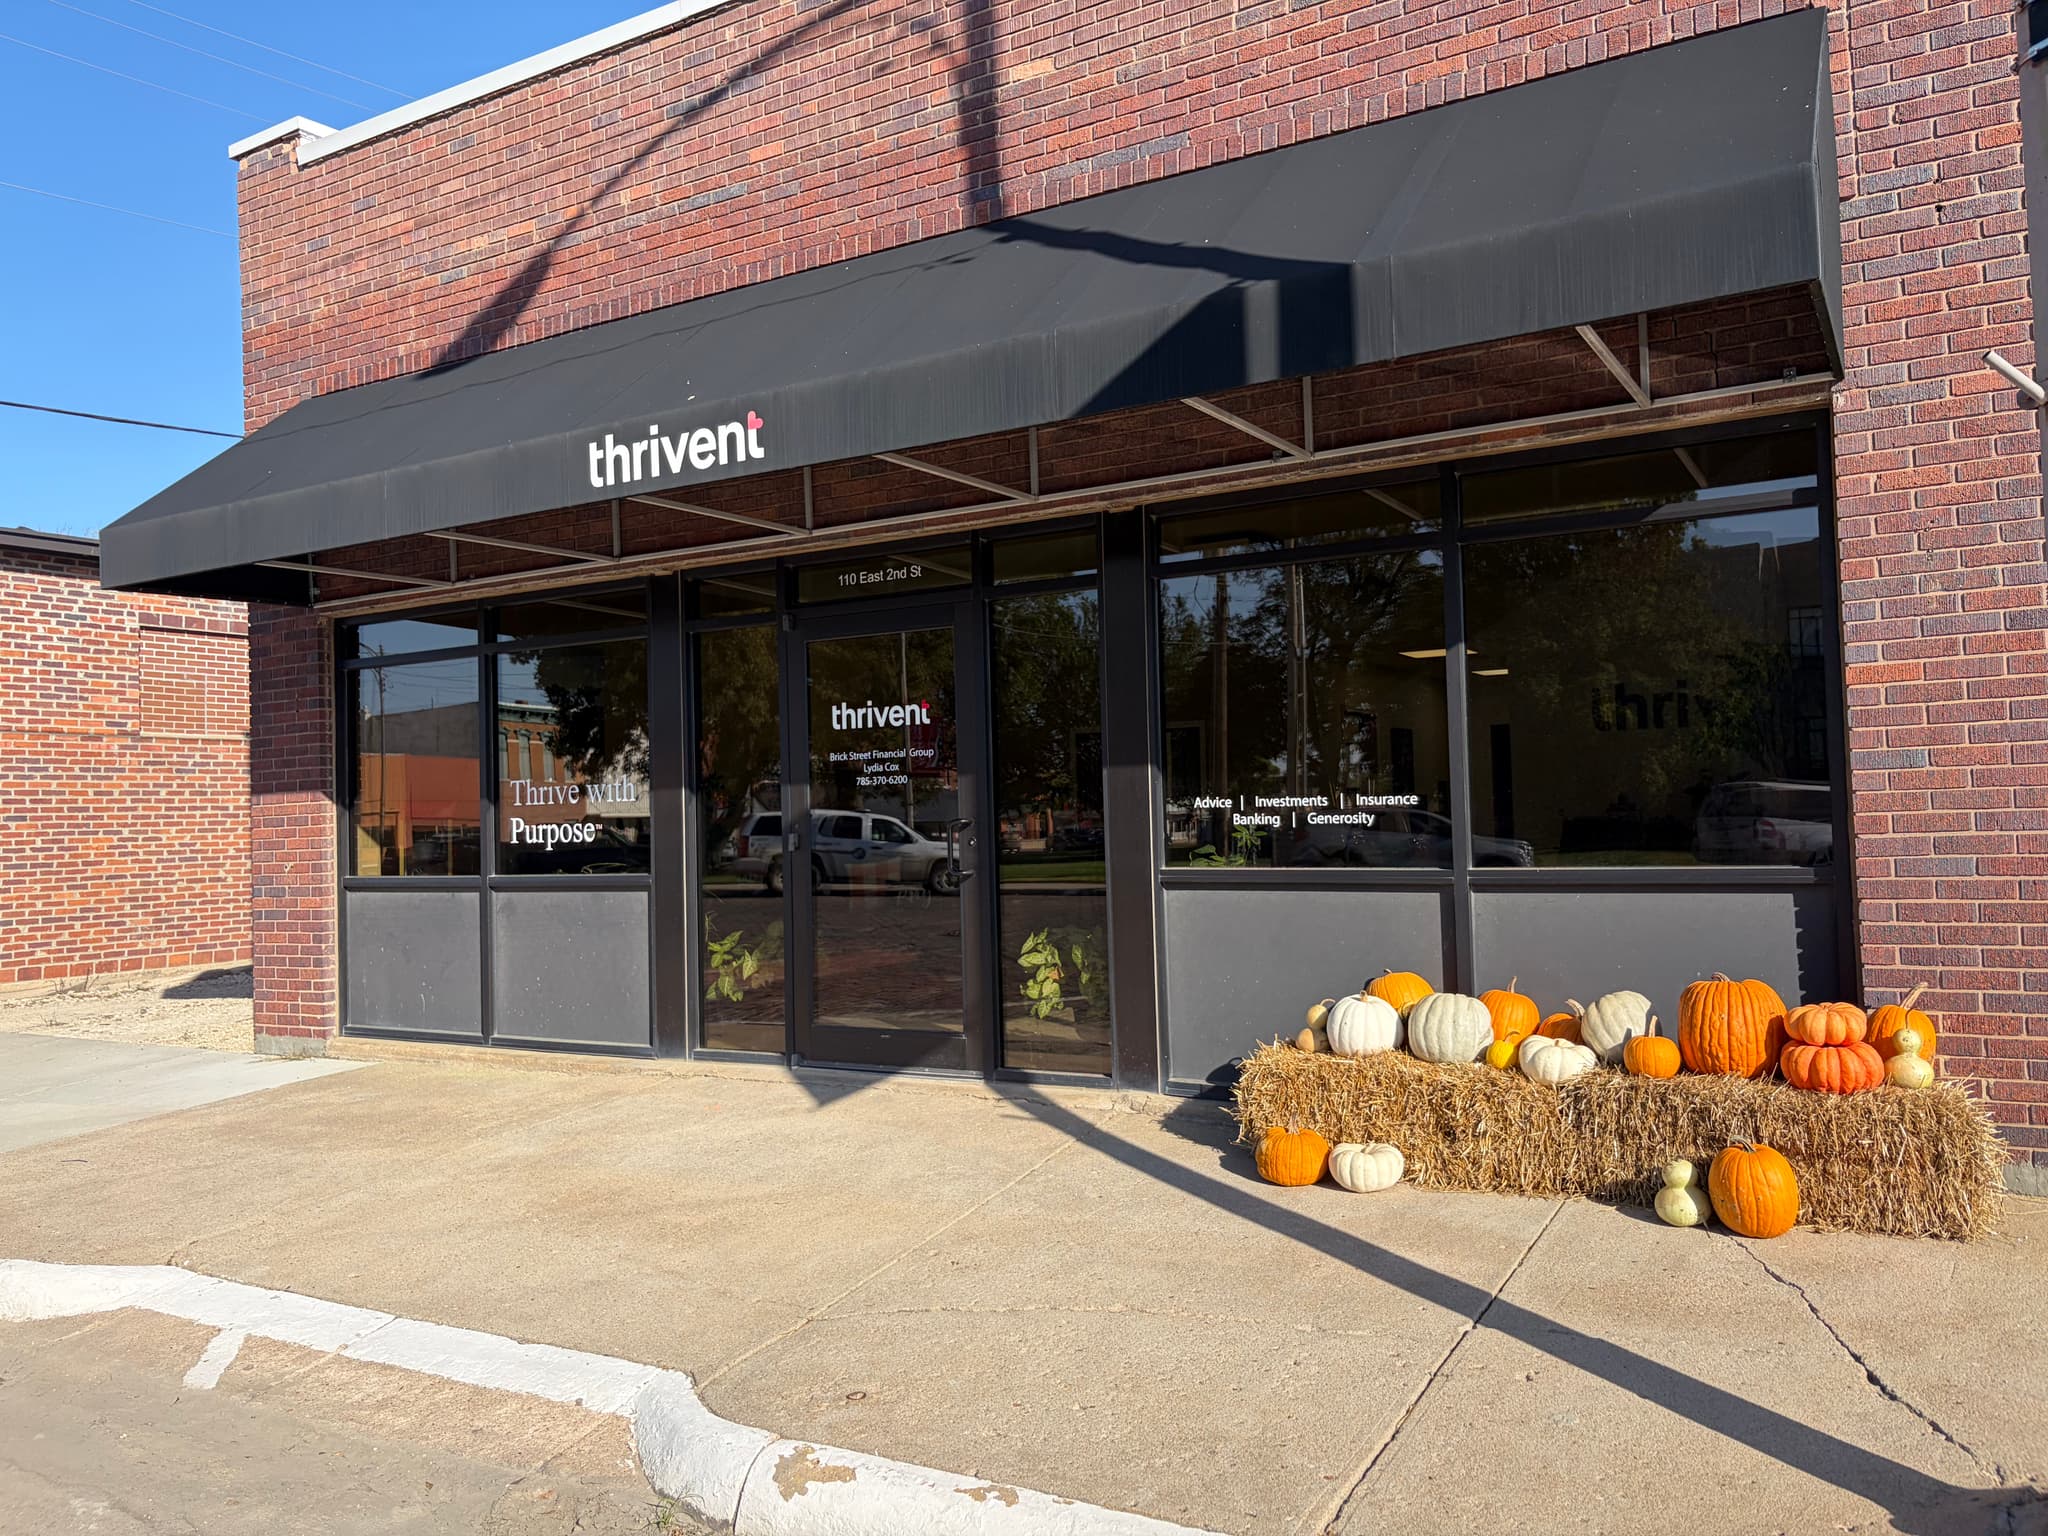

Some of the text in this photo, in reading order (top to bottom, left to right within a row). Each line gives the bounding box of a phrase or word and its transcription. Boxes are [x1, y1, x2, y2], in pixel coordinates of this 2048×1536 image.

[589, 410, 765, 488] thrivent
[839, 565, 922, 586] 110 East 2nd St
[831, 699, 931, 730] thrivent
[829, 747, 935, 762] Brick Street Financial Group
[863, 762, 900, 775] Lydia Cox
[856, 775, 908, 786] 785-370-6200
[510, 774, 637, 806] Thrive with
[1194, 796, 1233, 809] Advice
[1255, 795, 1329, 808] Investments
[1355, 793, 1419, 806] Insurance
[1232, 812, 1281, 828] Banking
[1307, 811, 1376, 827] Generosity
